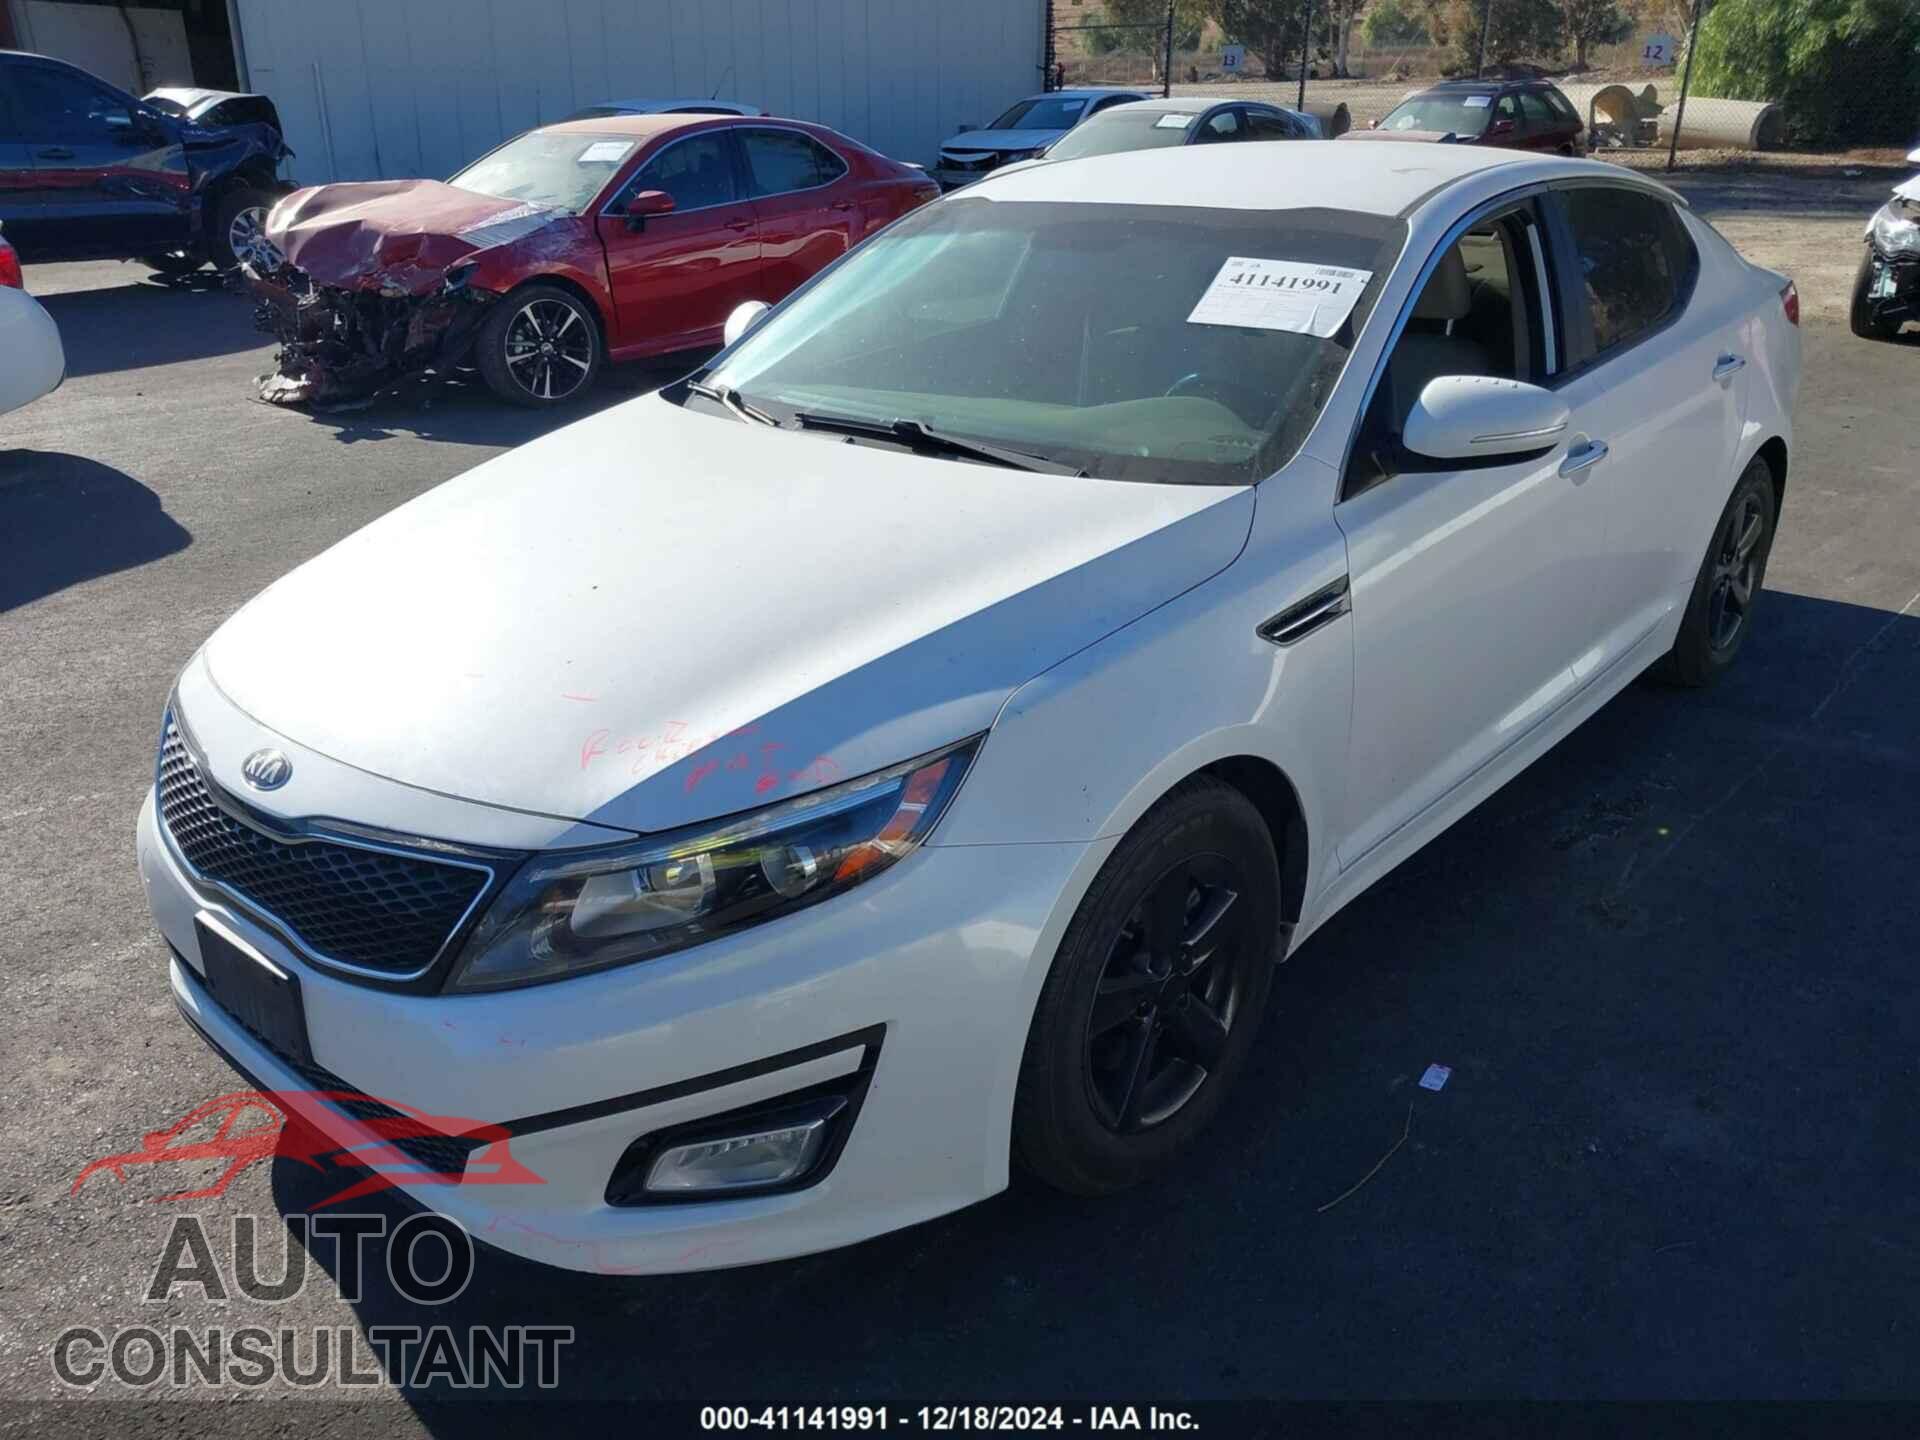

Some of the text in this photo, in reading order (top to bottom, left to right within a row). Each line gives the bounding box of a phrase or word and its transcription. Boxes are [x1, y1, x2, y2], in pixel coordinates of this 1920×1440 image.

[1223, 55, 1236, 66] 13
[1643, 45, 1663, 60] 12
[1229, 272, 1342, 295] 41141991
[246, 752, 283, 784] KIA
